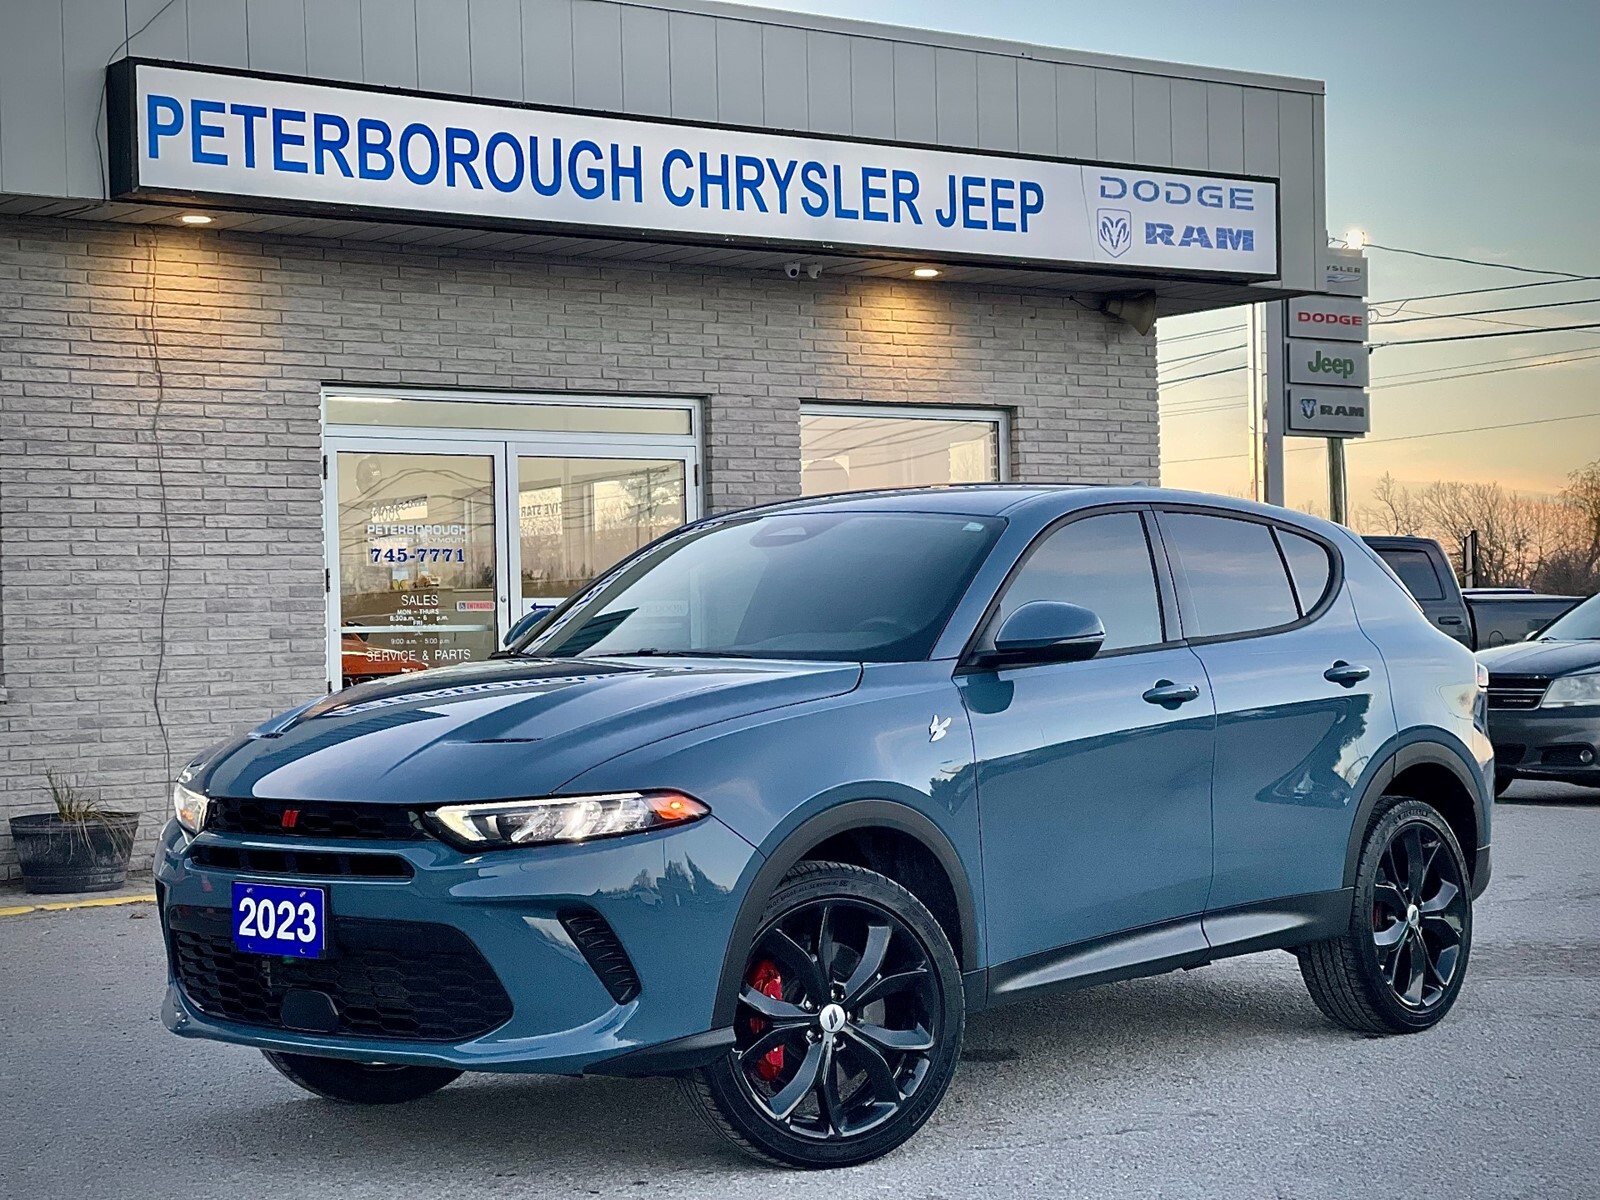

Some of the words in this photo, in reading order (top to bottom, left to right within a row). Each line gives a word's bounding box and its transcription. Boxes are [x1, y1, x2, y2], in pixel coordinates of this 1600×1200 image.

[146, 94, 643, 204] PETERBOROUGH
[661, 148, 923, 225] CHRYSLER
[936, 174, 1045, 234] JEEP
[1100, 176, 1254, 211] DODGE
[1145, 221, 1254, 252] RAM
[1297, 311, 1363, 326] DODGE
[1308, 350, 1355, 379] Jeep
[1320, 404, 1365, 418] RAM
[367, 524, 468, 535] PETERBOROUGH
[370, 547, 465, 563] 745-7771
[401, 594, 439, 606] SALES
[466, 601, 494, 610] ENTRANCE
[366, 650, 416, 662] SERVICE
[422, 650, 430, 661] &
[434, 649, 471, 660] PARTS
[238, 897, 317, 943] 2023
